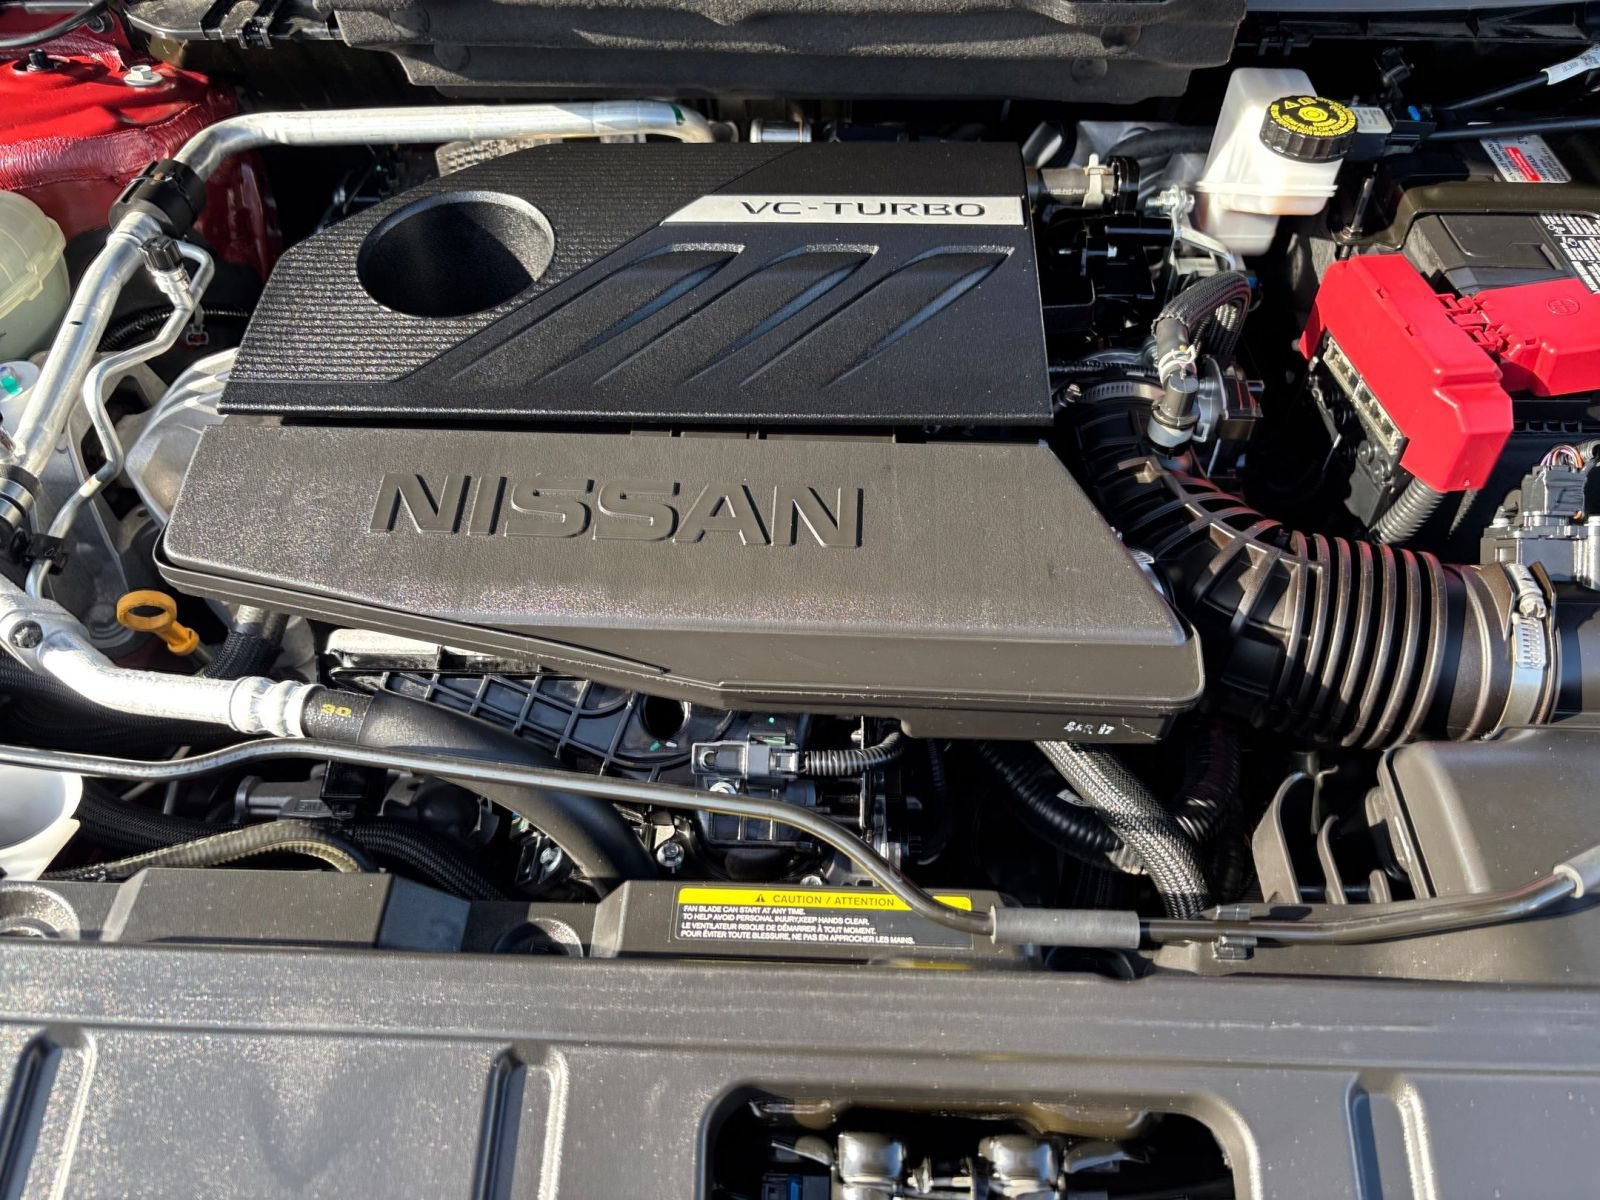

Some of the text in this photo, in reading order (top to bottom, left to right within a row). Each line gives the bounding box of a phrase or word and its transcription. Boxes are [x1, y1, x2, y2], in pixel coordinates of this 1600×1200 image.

[740, 201, 986, 217] VC-TURBO
[367, 474, 864, 548] NISSAN
[773, 895, 822, 904] CAUTION
[834, 896, 895, 906] ATTENTION
[698, 905, 722, 913] BLADE
[740, 906, 761, 914] START
[844, 917, 870, 925] CLEAR.
[692, 922, 737, 930] VENTILATEUR
[738, 923, 765, 931] RISQUE
[777, 923, 816, 932] DÉMARRER
[817, 924, 824, 932] À
[843, 927, 877, 935] MOMENT.
[702, 929, 727, 938] ÉVITER
[752, 932, 791, 941] BLESSURE,
[830, 934, 875, 943] APPROCHER
[890, 936, 916, 944] MAINS.
